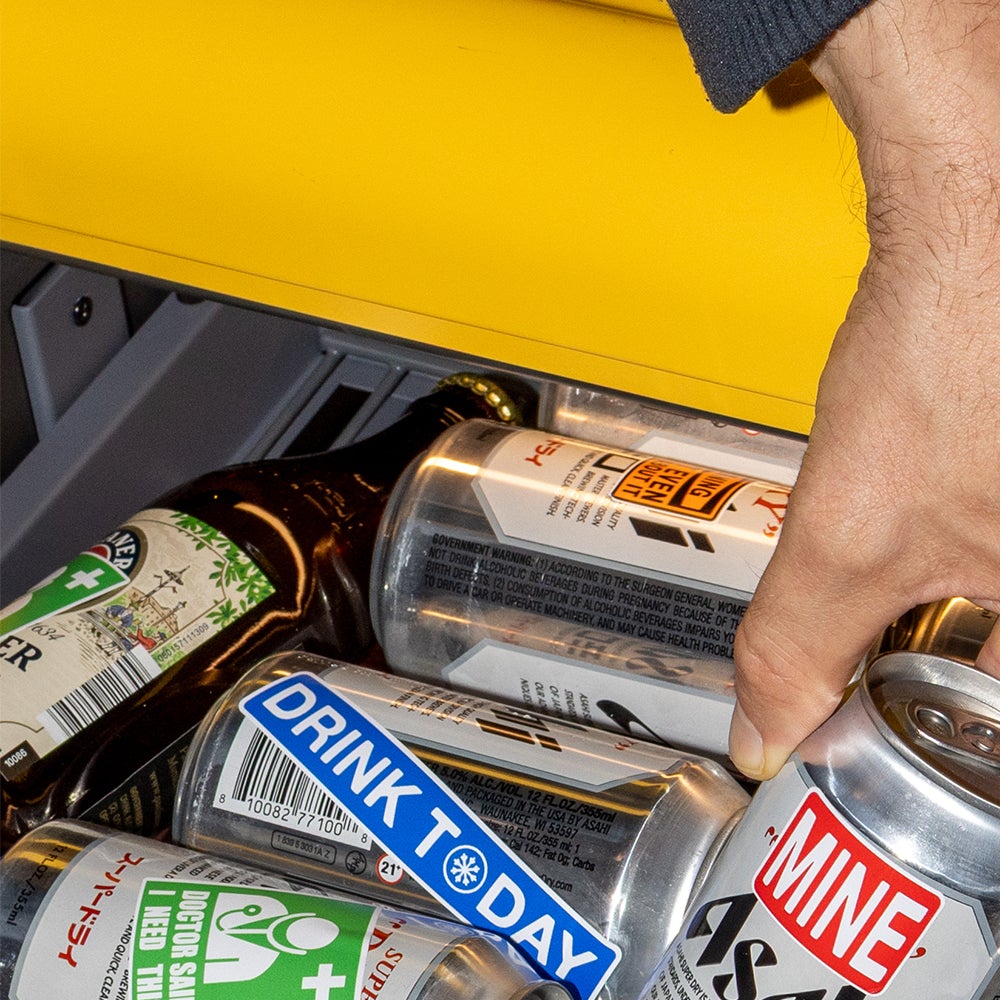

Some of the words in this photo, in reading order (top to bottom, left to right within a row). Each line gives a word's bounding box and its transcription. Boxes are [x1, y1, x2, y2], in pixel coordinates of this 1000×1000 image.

[4, 748, 28, 768] 10086
[262, 682, 422, 829] DRINK
[248, 799, 290, 821] 10082
[298, 812, 343, 836] 77100
[58, 852, 145, 968] スーパードライ
[139, 906, 172, 951] NEED
[171, 890, 211, 959] DOCTOR
[762, 807, 929, 983] MINE
